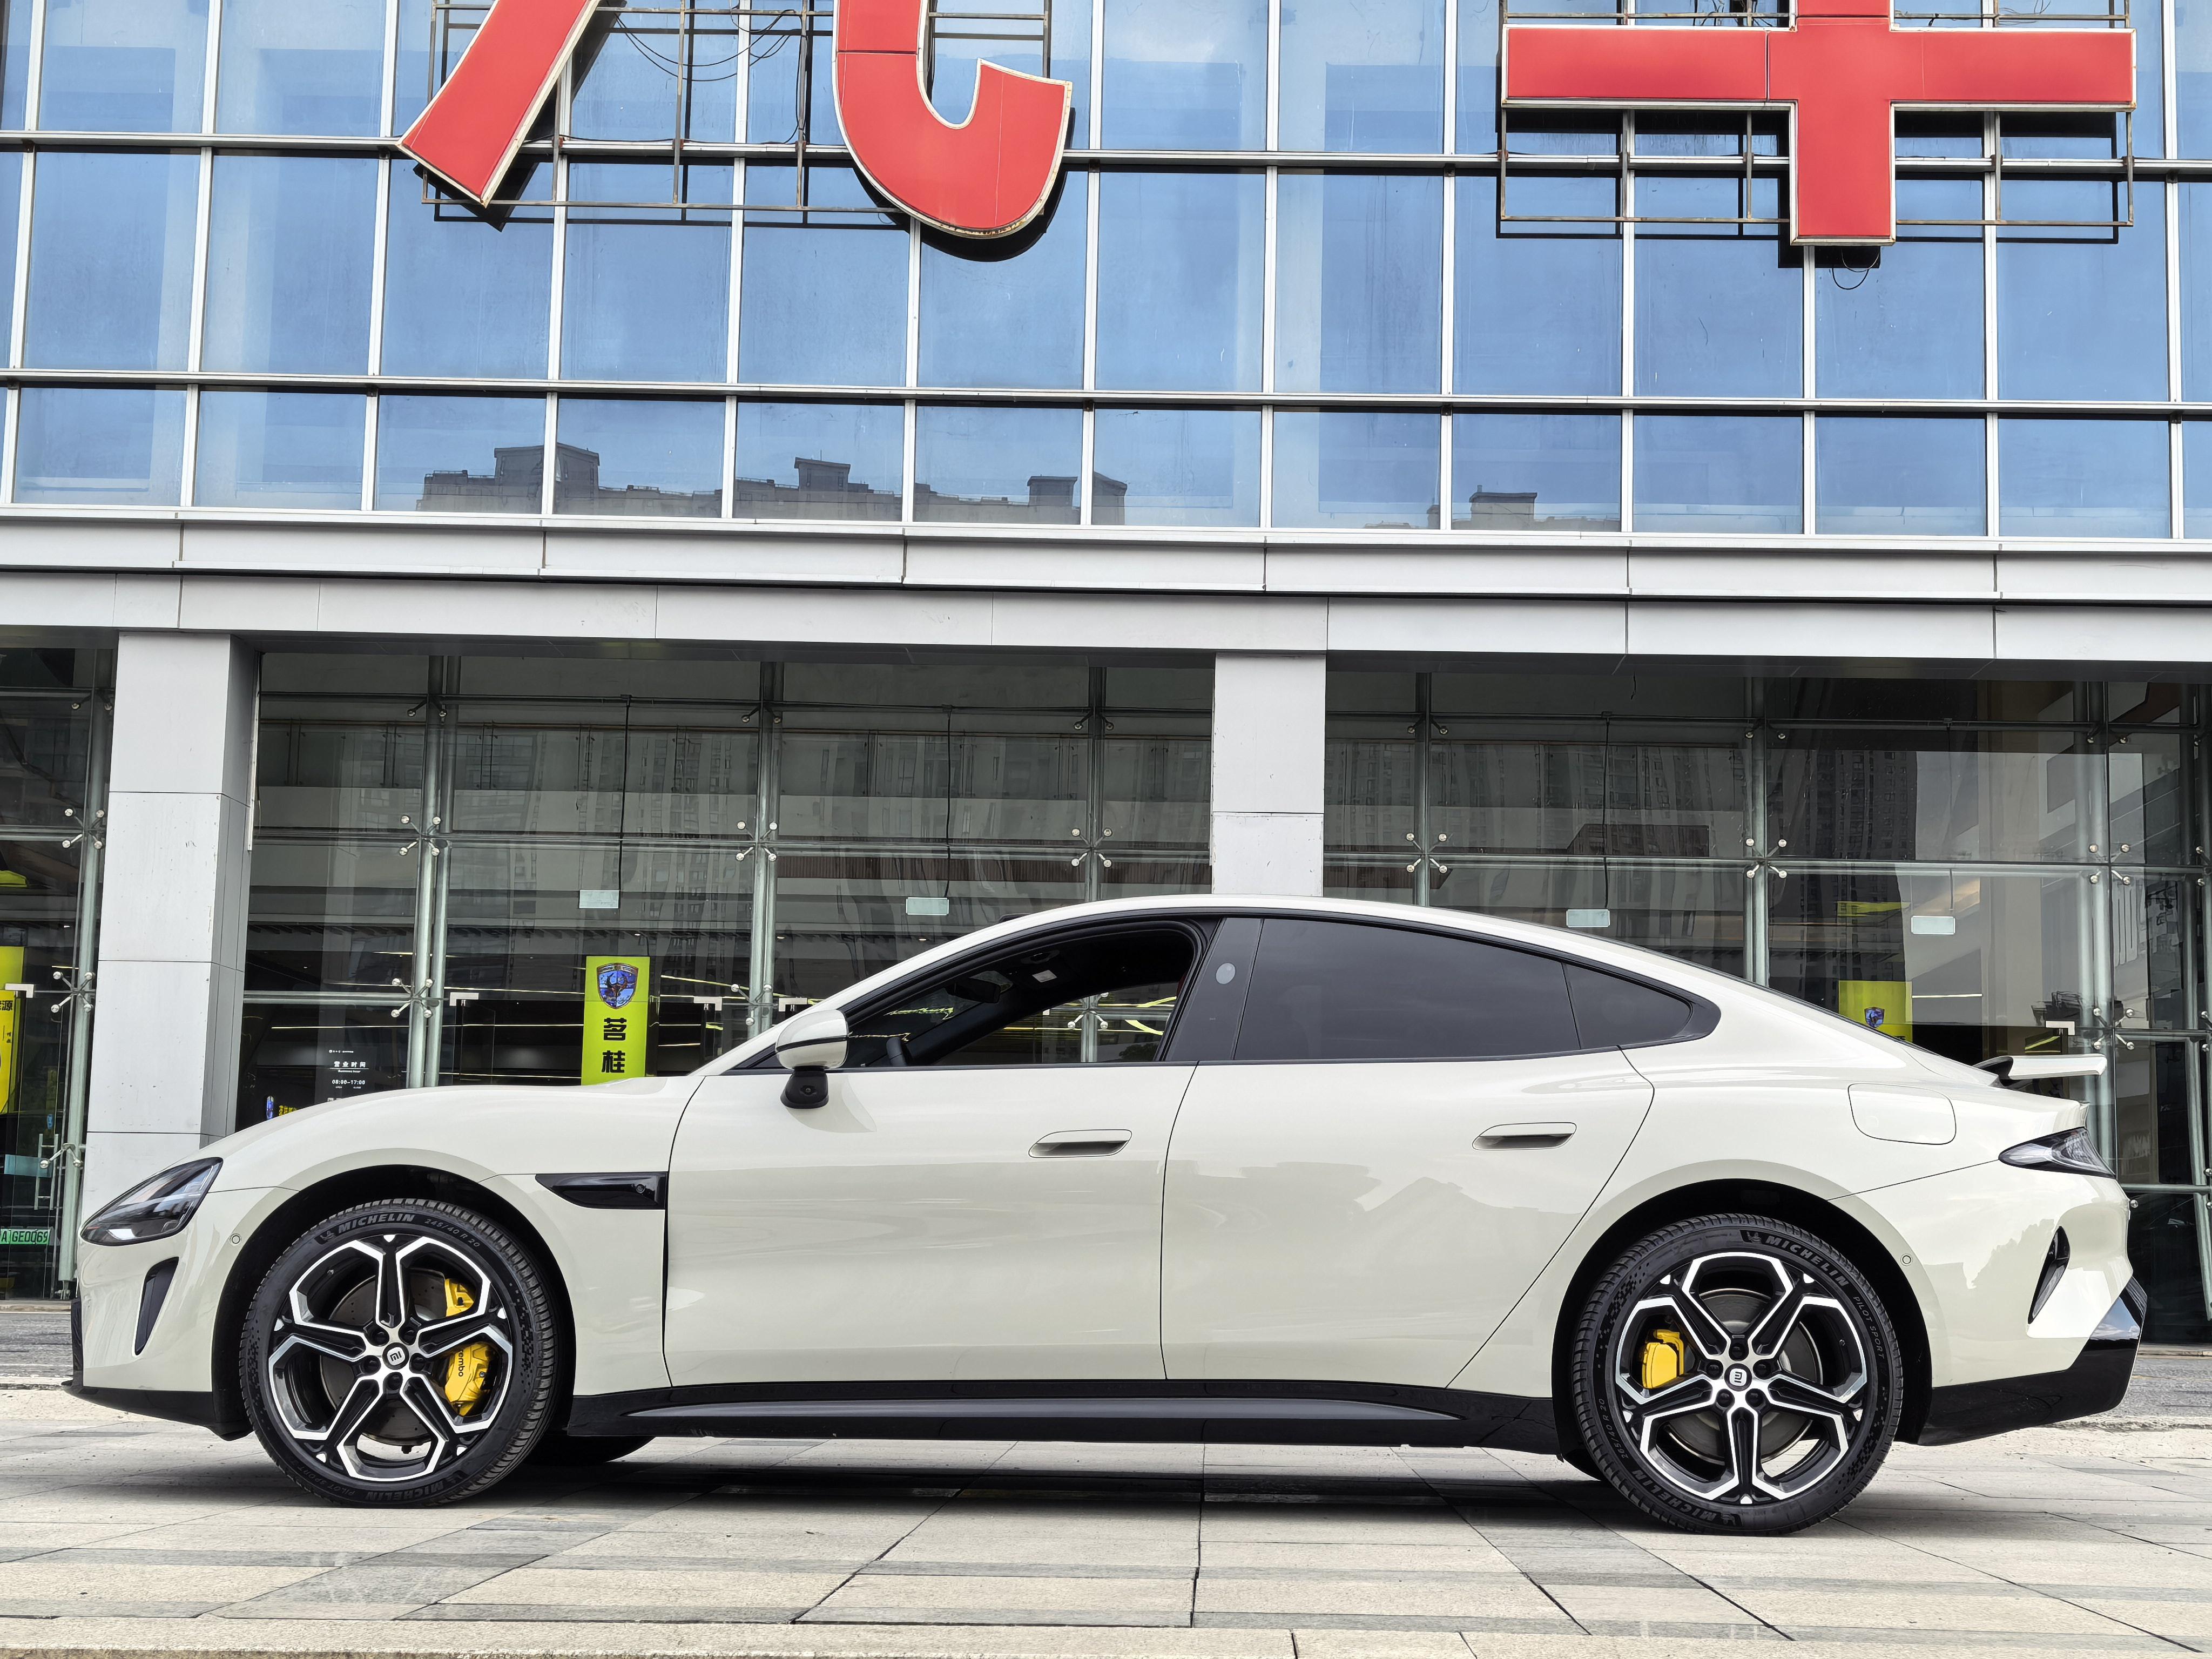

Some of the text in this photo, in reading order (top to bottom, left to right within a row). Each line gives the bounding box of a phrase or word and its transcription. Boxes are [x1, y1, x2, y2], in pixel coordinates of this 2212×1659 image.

[0, 1000, 13, 1011] 源
[602, 1017, 627, 1073] 茗桂
[338, 1213, 415, 1233] MICHELIN
[424, 1219, 459, 1234] 245/40
[468, 1238, 480, 1247] 20
[1765, 1235, 1849, 1287] MICHELIN
[1853, 1296, 1873, 1323] PILOT
[1870, 1326, 1885, 1360] SPORT
[1599, 1399, 1606, 1411] 20
[1606, 1424, 1629, 1458] 265/40
[365, 1480, 444, 1501] MICHELIN
[1632, 1469, 1717, 1521] MICHELIN
